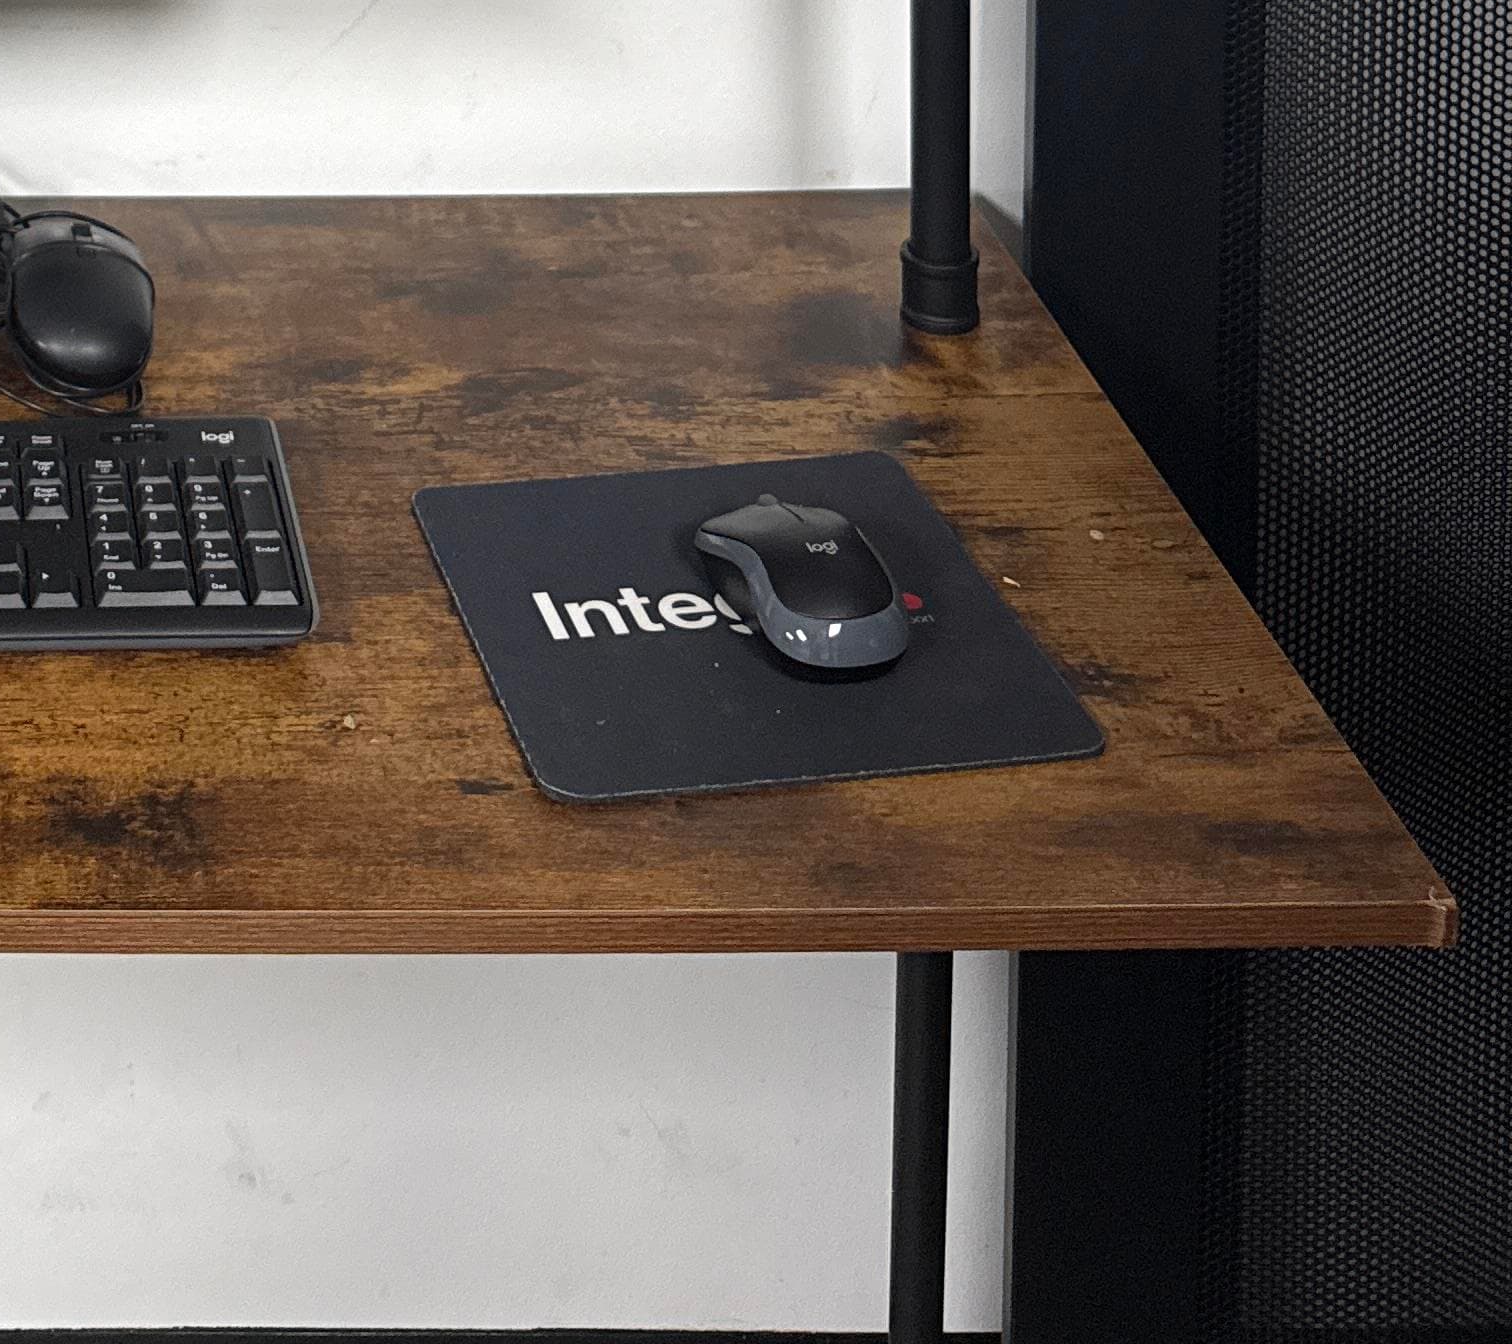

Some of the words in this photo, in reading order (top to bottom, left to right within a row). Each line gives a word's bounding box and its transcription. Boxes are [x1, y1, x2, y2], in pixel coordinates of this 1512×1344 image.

[202, 431, 234, 444] logi
[805, 539, 839, 555] logi
[532, 587, 754, 640] Inte
